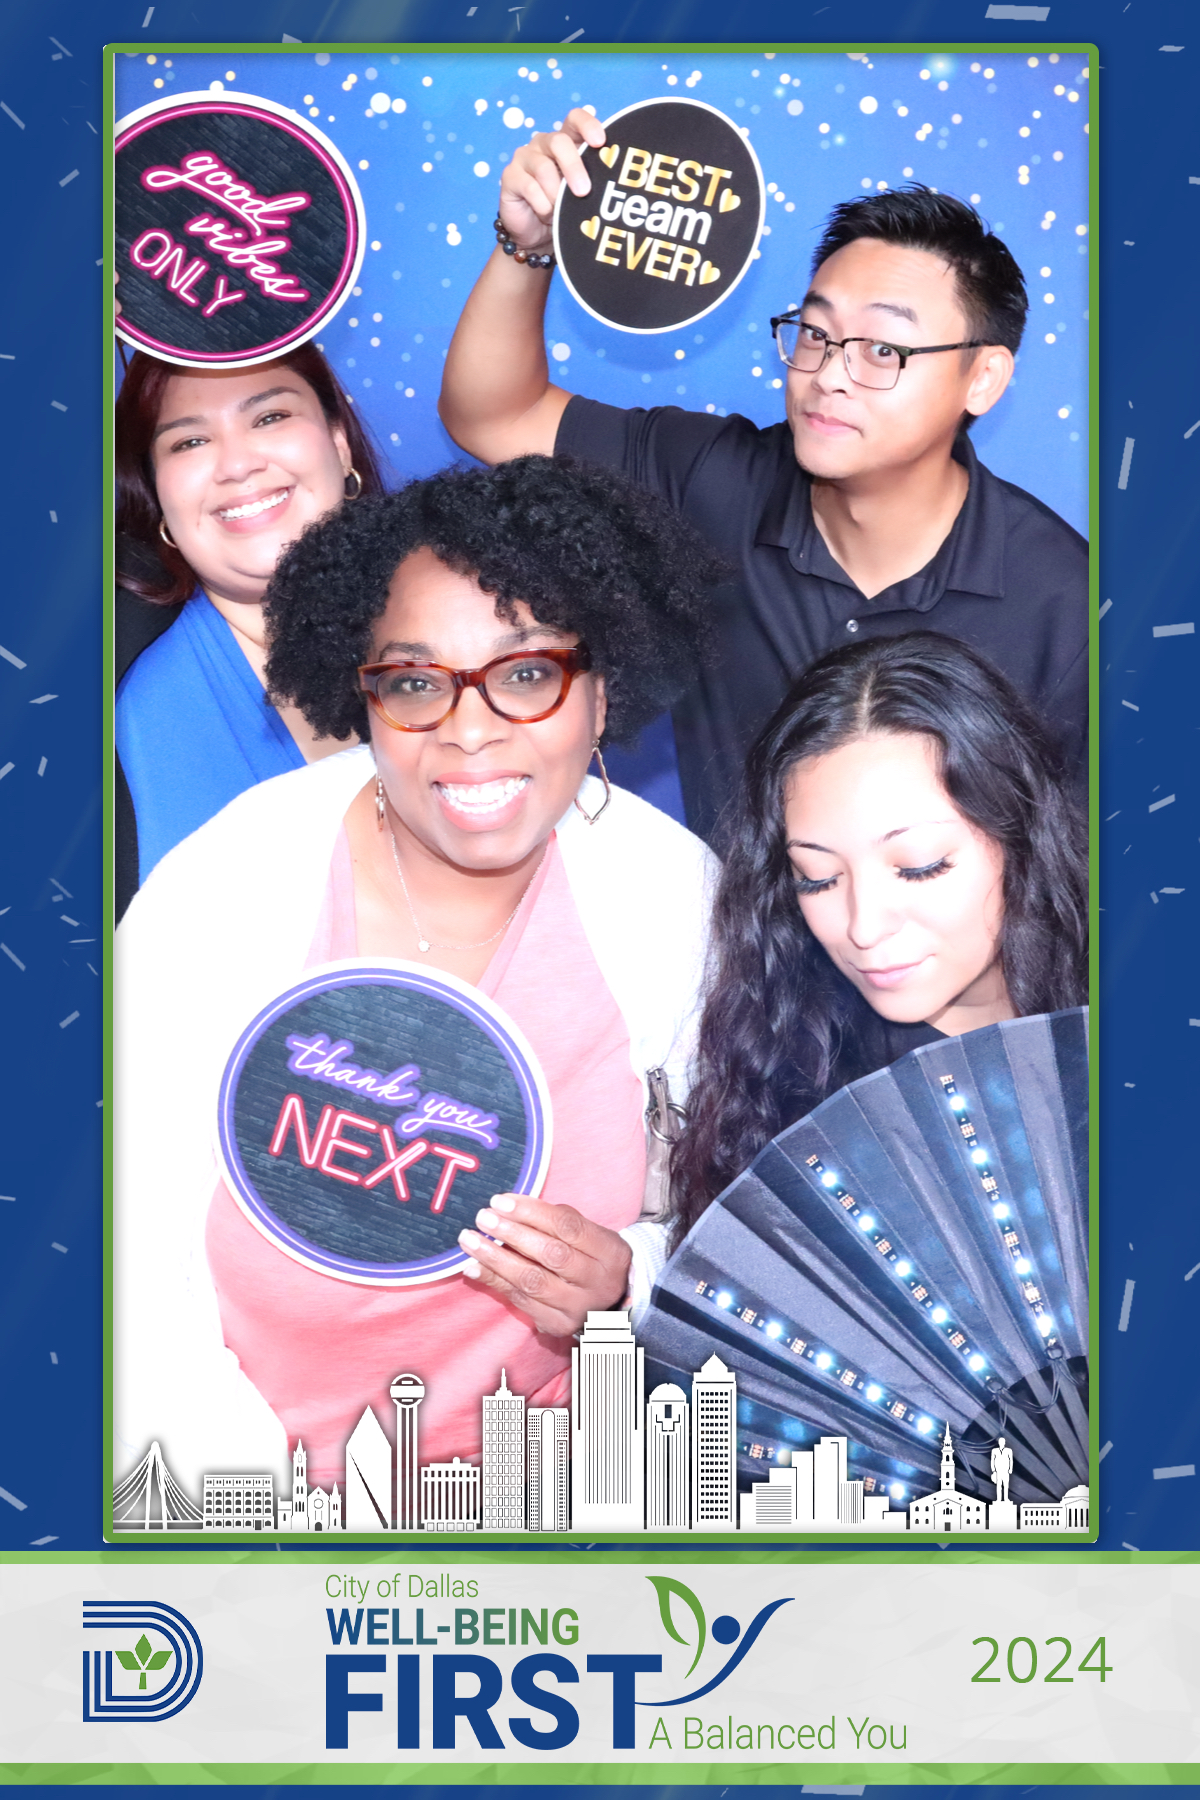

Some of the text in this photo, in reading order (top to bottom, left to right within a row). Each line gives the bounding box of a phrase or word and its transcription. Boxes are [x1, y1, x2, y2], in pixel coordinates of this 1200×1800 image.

[143, 153, 309, 238] good
[600, 180, 712, 245] team
[618, 147, 732, 207] BEST
[131, 229, 245, 316] ONLY
[186, 215, 308, 299] vibes
[595, 225, 701, 287] EVER
[288, 1035, 497, 1147] thank you
[269, 1095, 478, 1212] NEXT
